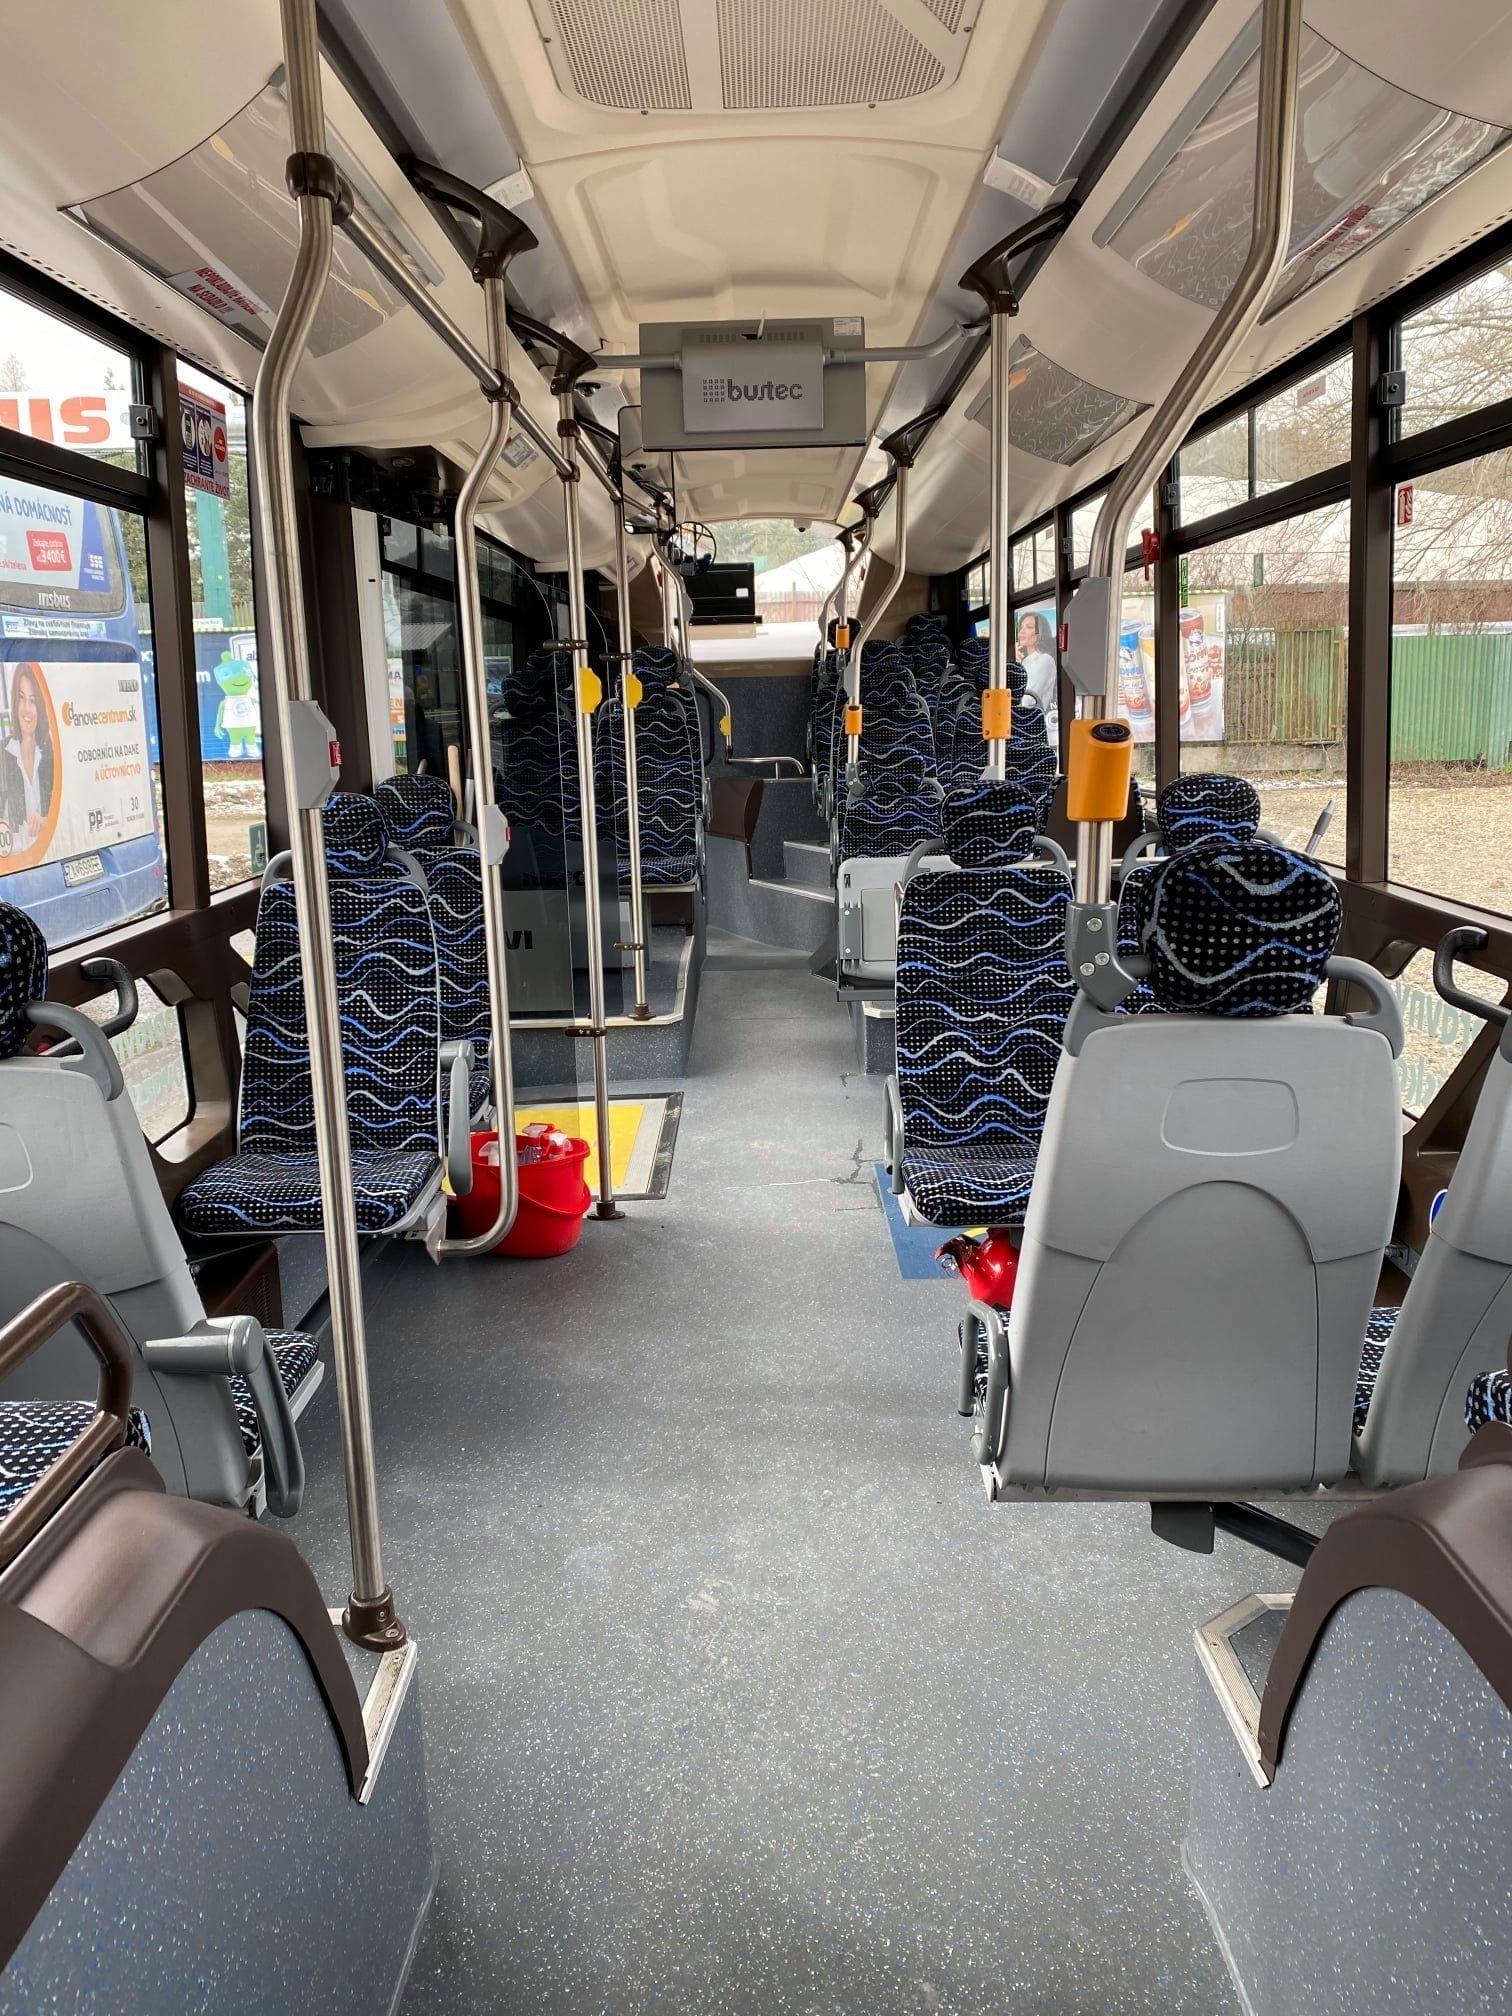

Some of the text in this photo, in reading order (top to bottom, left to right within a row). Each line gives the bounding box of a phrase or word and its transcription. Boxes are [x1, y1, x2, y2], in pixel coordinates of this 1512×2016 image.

[77, 743, 140, 763] ODBORNÍCI NA DANE
